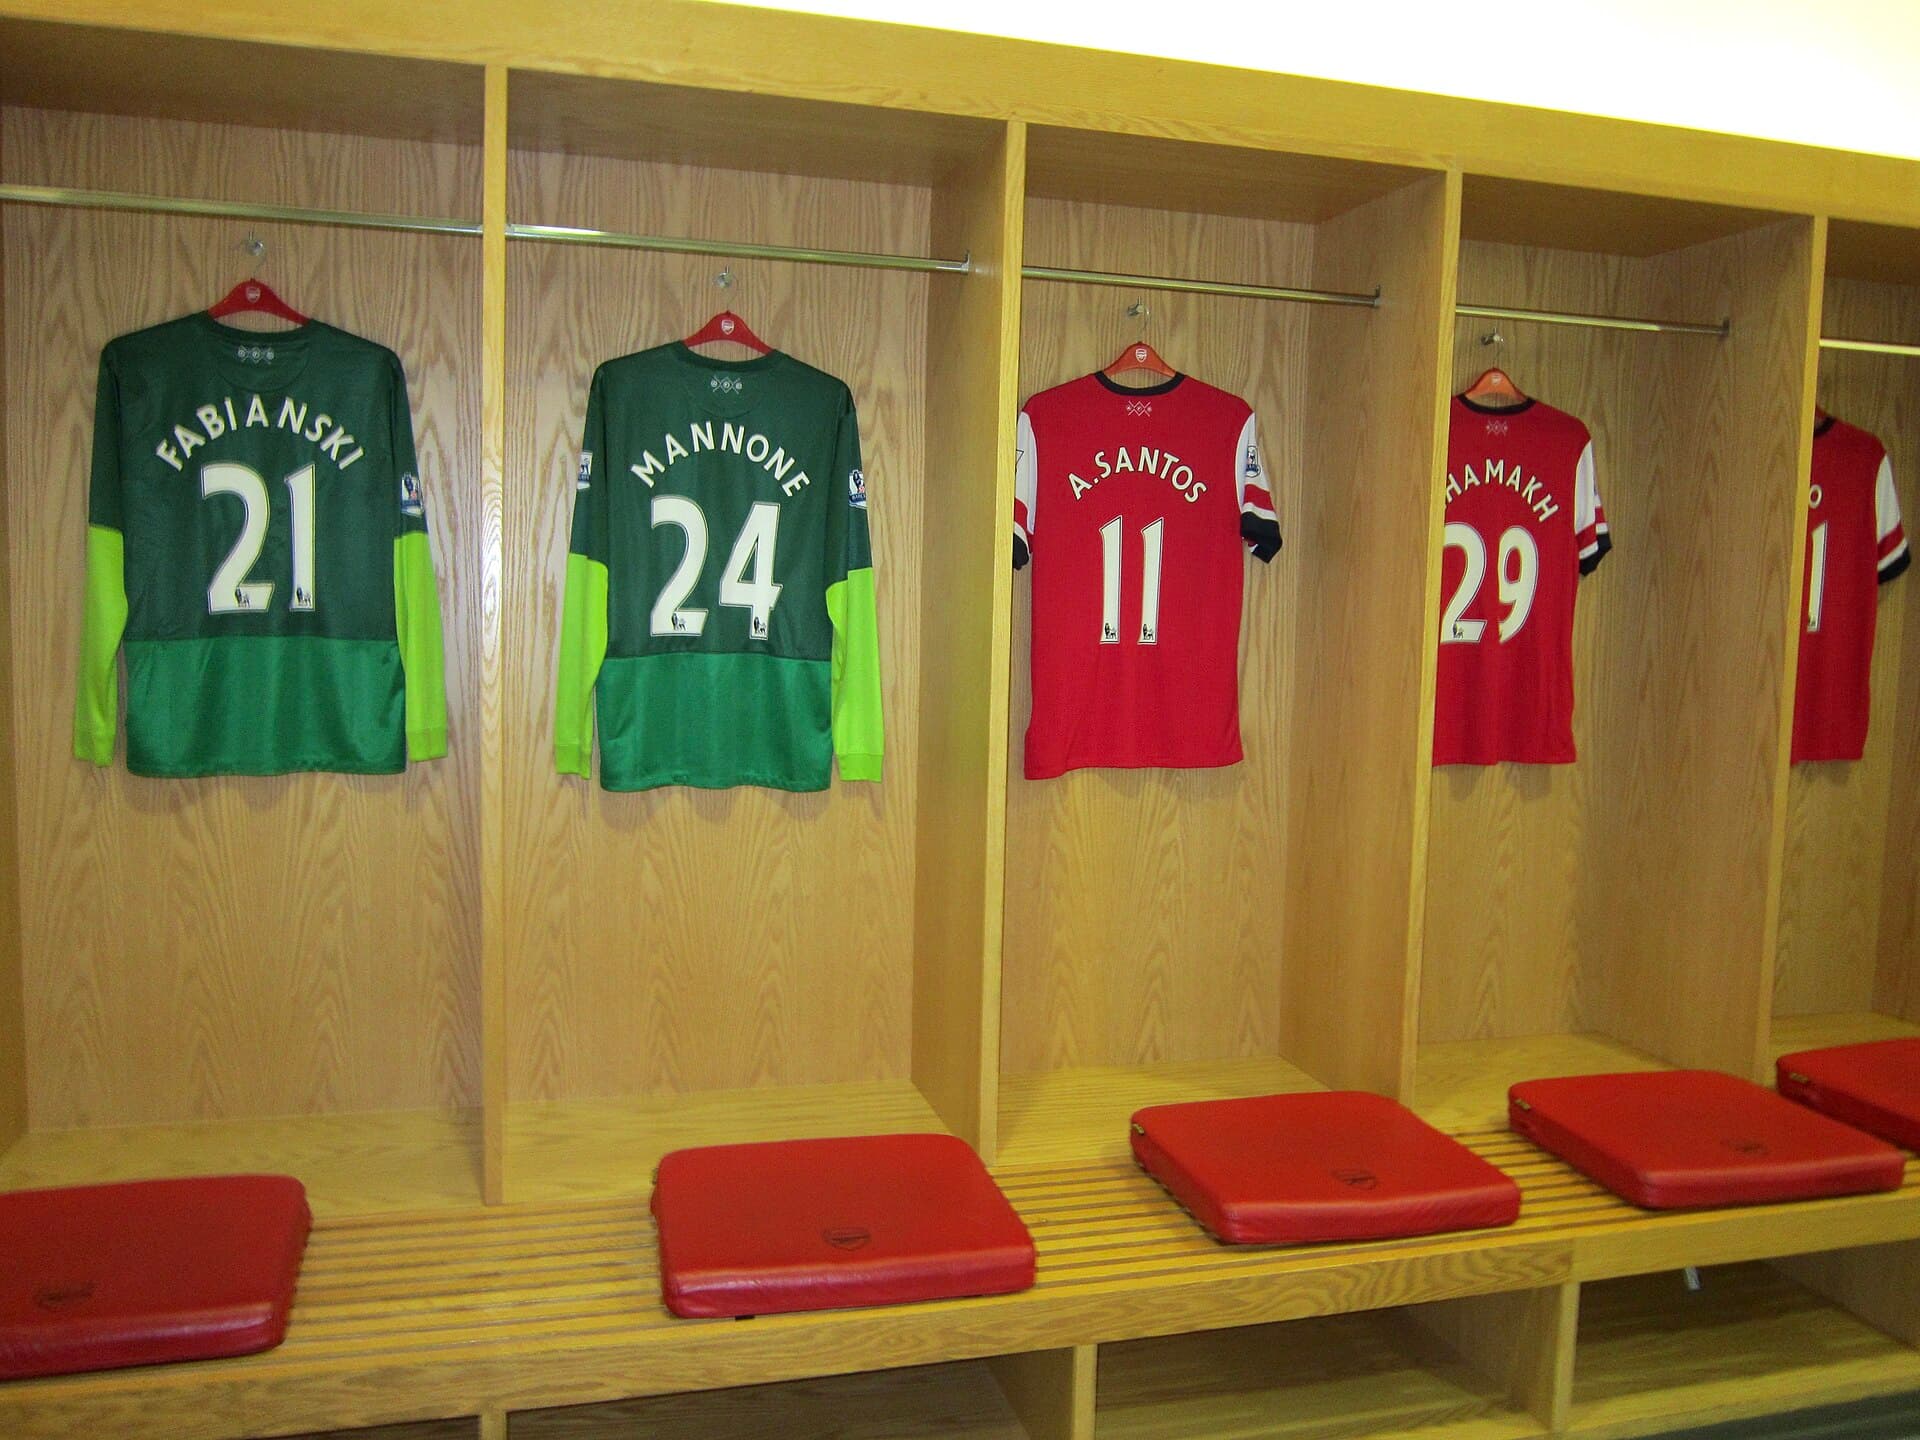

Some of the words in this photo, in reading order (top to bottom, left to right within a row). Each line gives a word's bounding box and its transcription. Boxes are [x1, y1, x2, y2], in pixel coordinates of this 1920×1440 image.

[156, 394, 365, 472] FABIANSKI
[630, 420, 811, 497] MANNONE
[1067, 446, 1207, 503] A.SANTOS
[201, 462, 316, 615] 21
[1443, 458, 1559, 522] HAMAKH
[650, 494, 784, 640] 24
[1099, 515, 1164, 645] 11
[1440, 522, 1539, 644] 29
